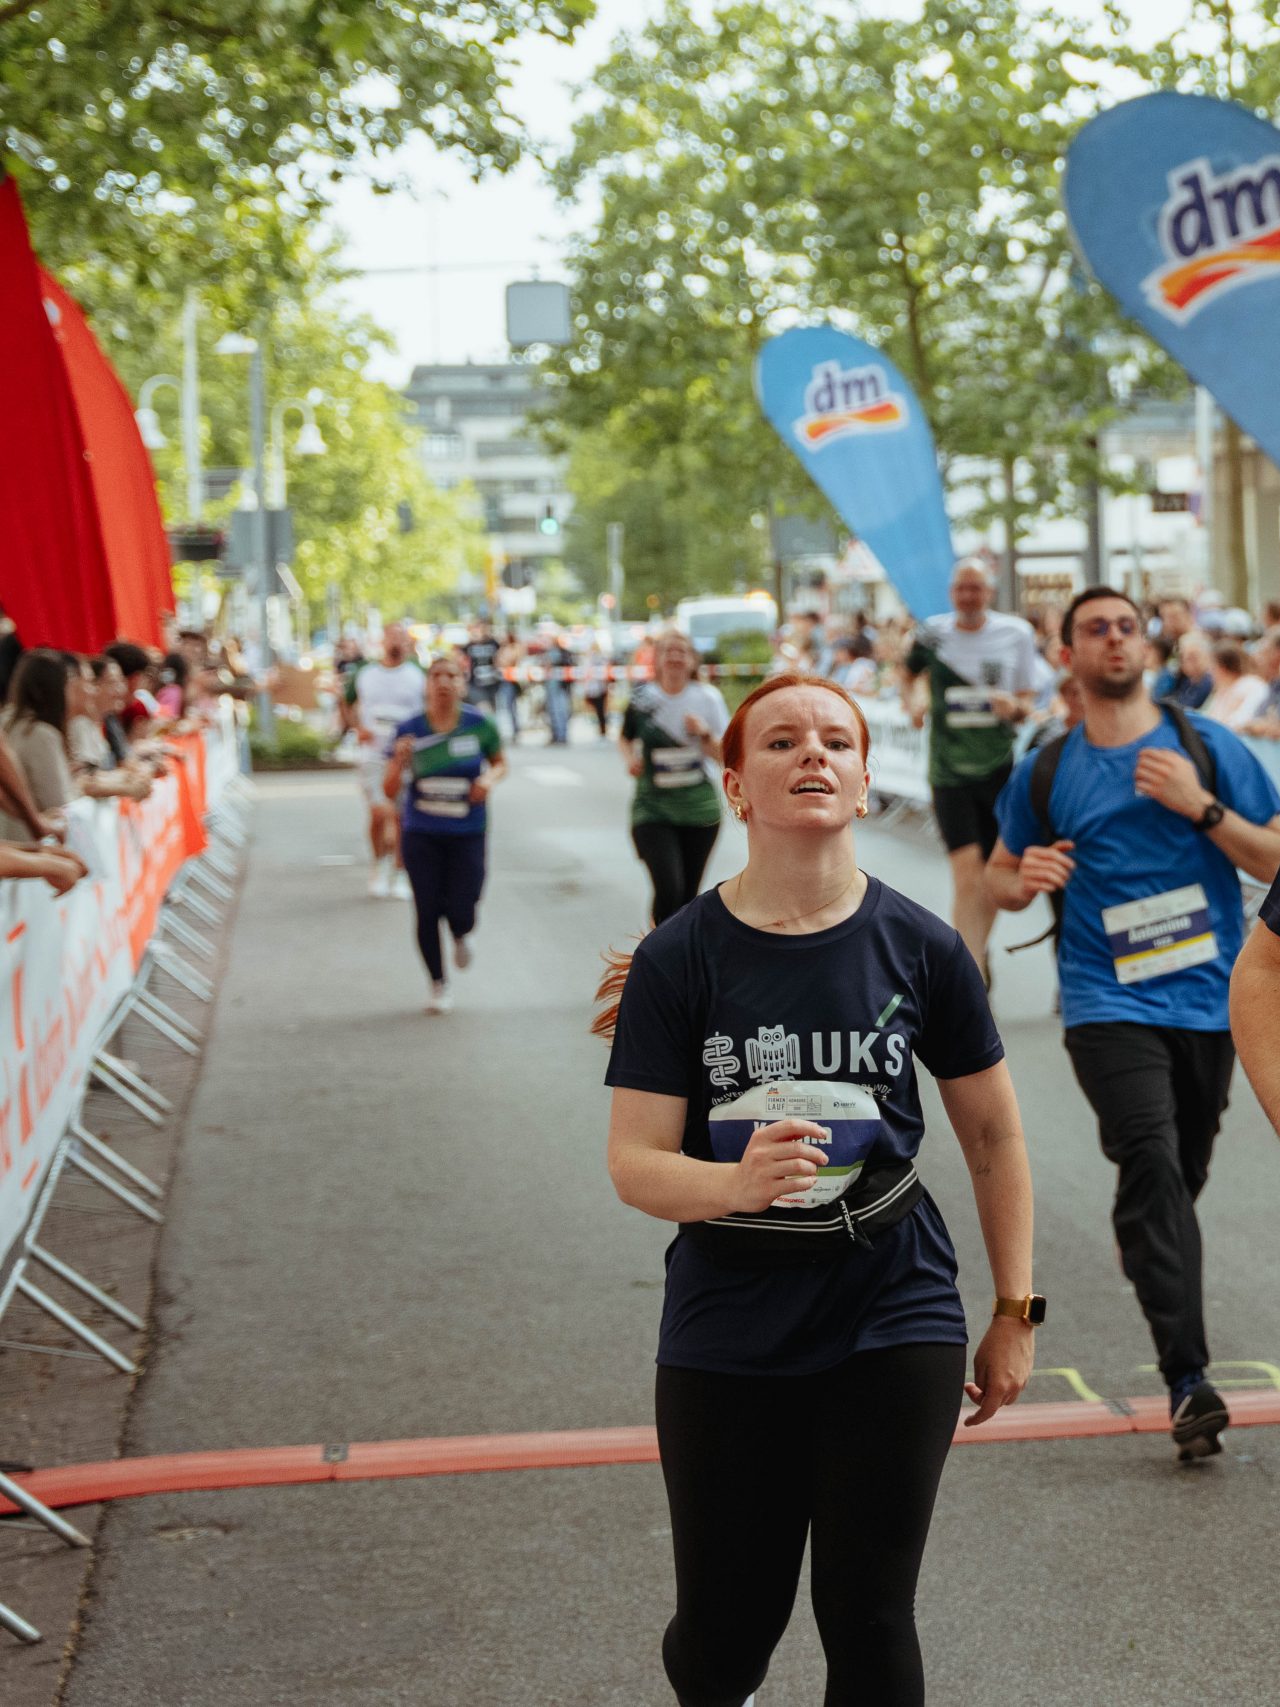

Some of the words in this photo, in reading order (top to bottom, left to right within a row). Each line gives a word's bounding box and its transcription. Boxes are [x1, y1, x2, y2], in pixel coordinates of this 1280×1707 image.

[813, 369, 881, 413] dm
[811, 1031, 906, 1077] UKS
[767, 1103, 785, 1111] LAUF
